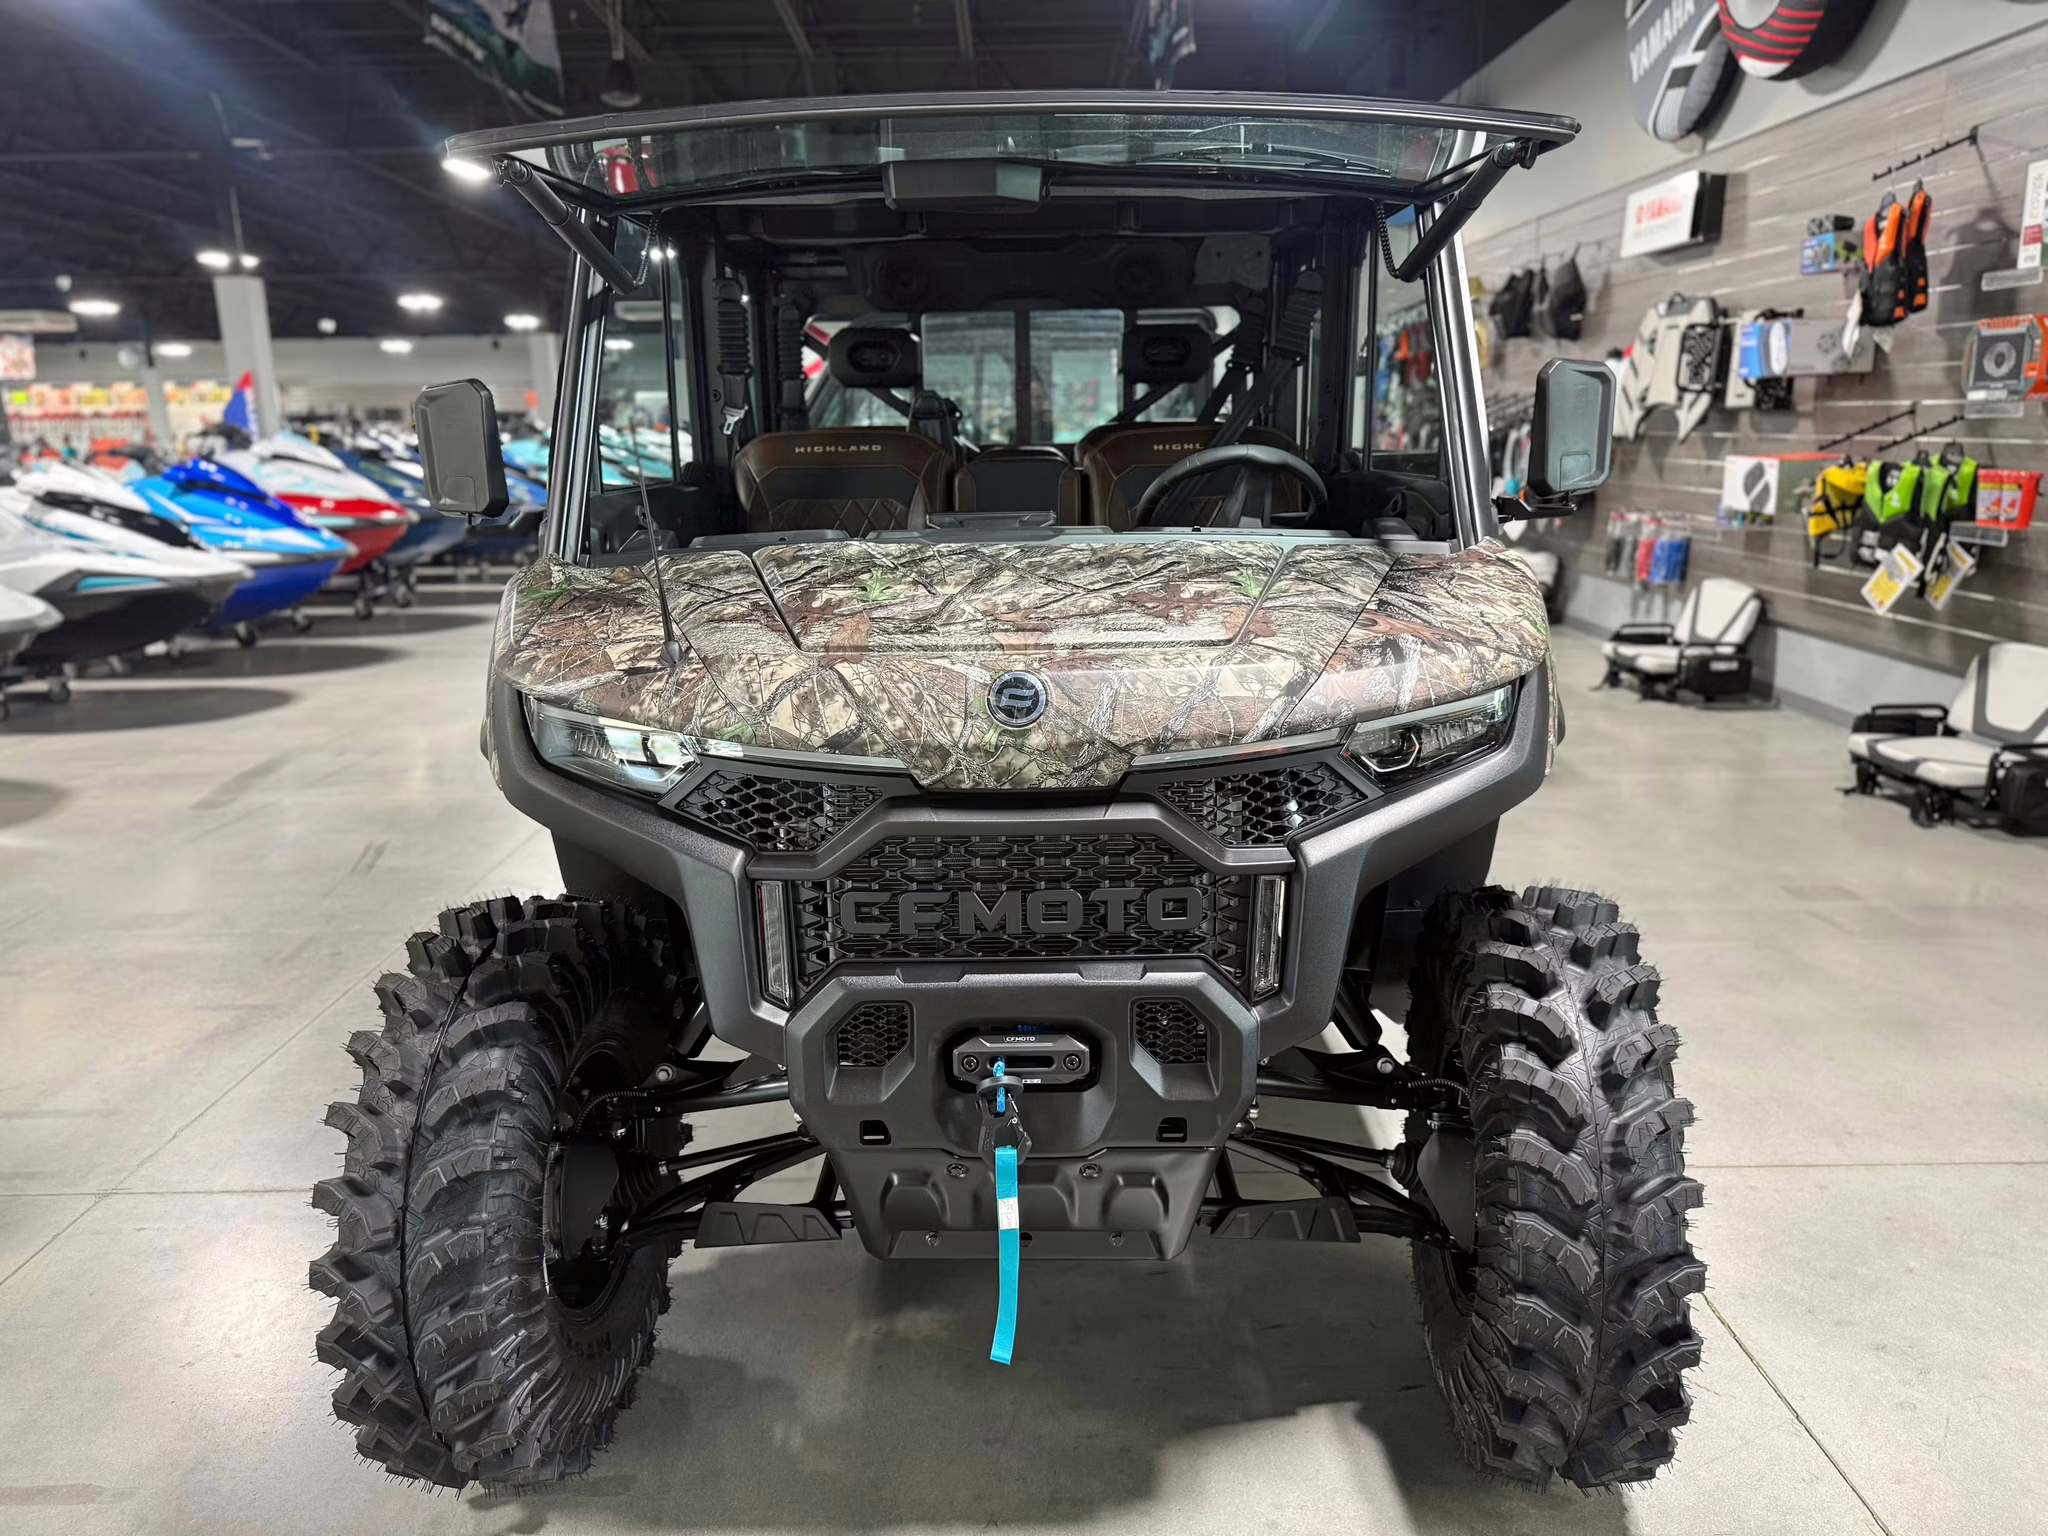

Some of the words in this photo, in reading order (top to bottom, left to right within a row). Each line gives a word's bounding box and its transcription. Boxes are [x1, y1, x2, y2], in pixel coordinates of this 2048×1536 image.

[795, 444, 882, 453] HIGHLAND
[1153, 443, 1205, 451] HIGHL
[840, 887, 1202, 935] CFMOTO
